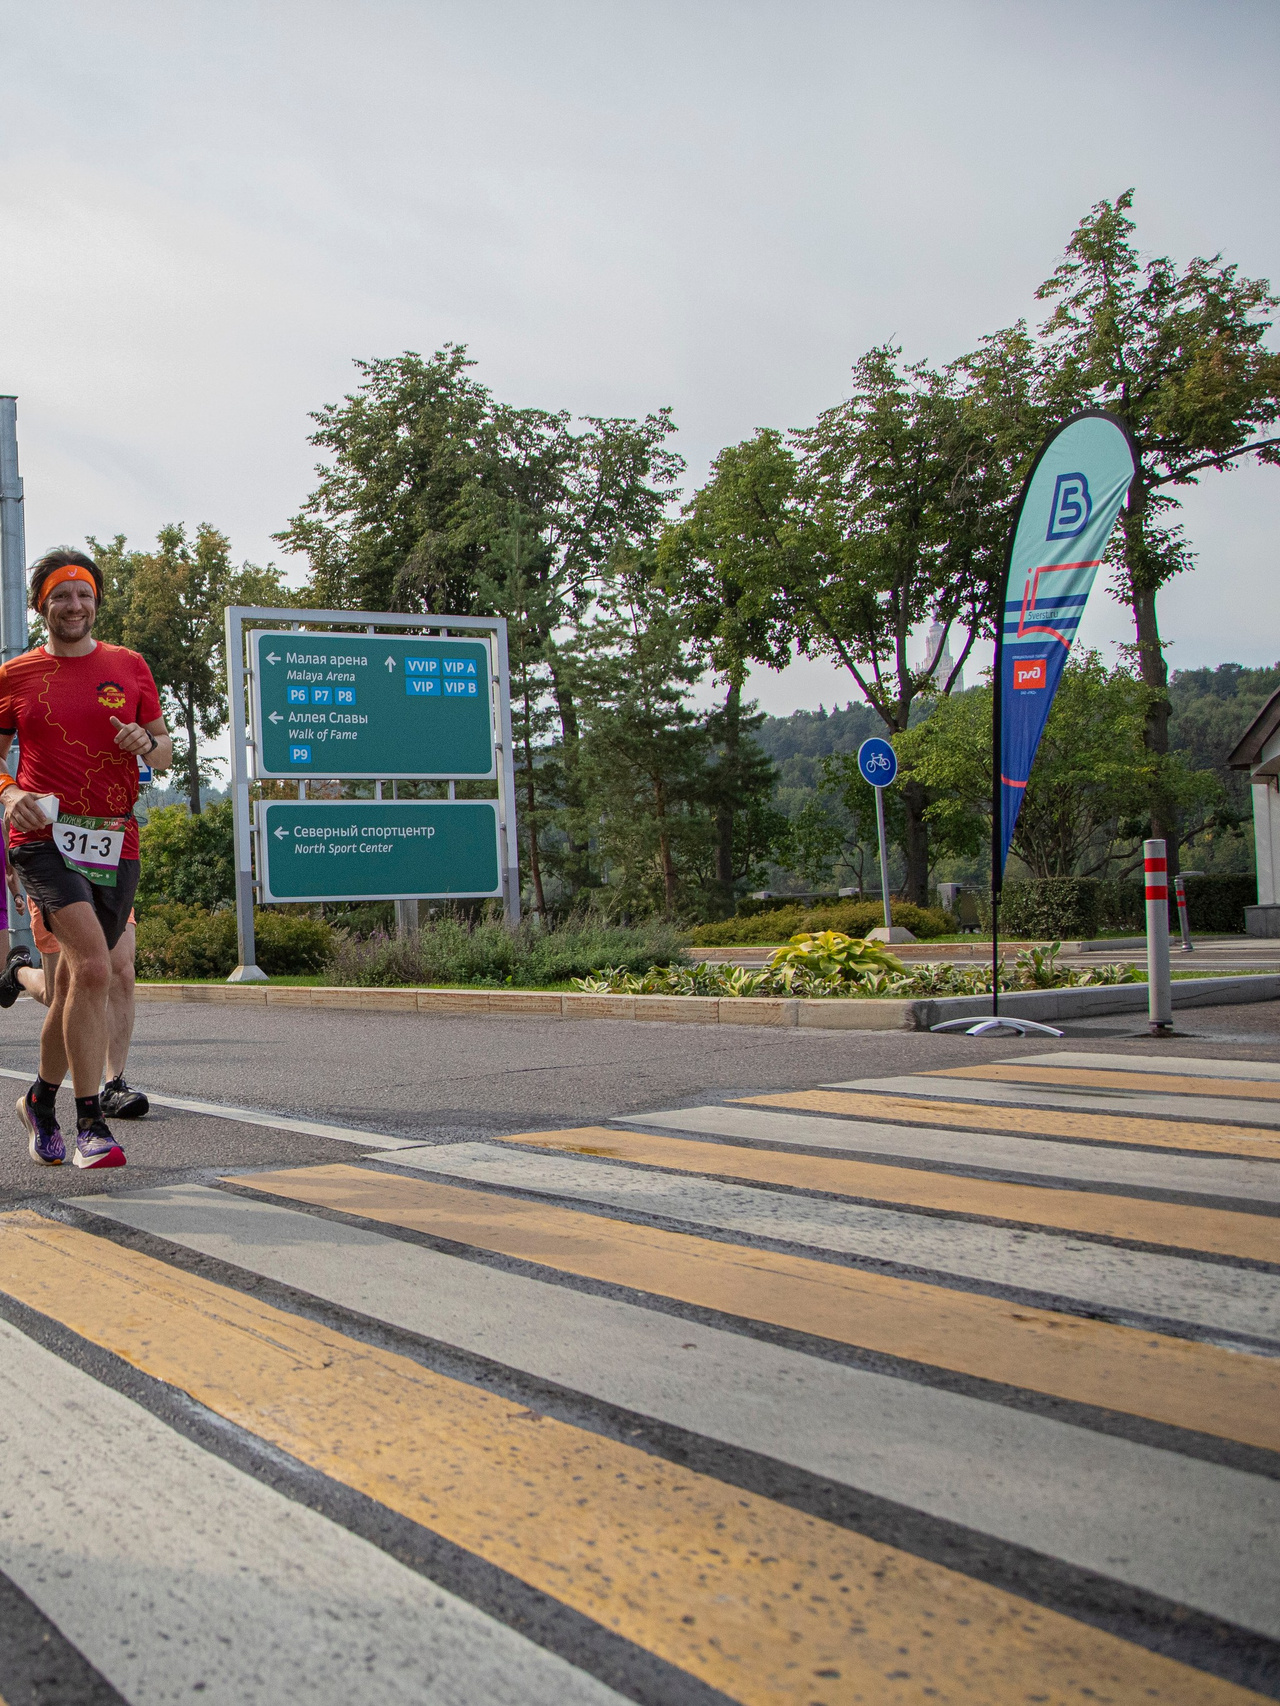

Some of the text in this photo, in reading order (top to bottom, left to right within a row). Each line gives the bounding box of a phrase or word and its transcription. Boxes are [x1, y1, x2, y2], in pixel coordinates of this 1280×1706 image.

[1027, 610, 1059, 620] 5verst.ru
[286, 652, 368, 668] Малая арена
[408, 660, 476, 674] VVIP VIP A
[286, 670, 356, 683] Malaya Arena
[413, 681, 477, 694] VIP VIP B
[291, 689, 353, 702] P6 P7 P8
[288, 711, 368, 724] Аллея Славы
[288, 728, 358, 742] Walk of Fame
[293, 748, 308, 760] P9
[293, 825, 435, 840] Северный спортцентр
[62, 831, 112, 857] 31-3
[294, 843, 393, 856] North Sport Center
